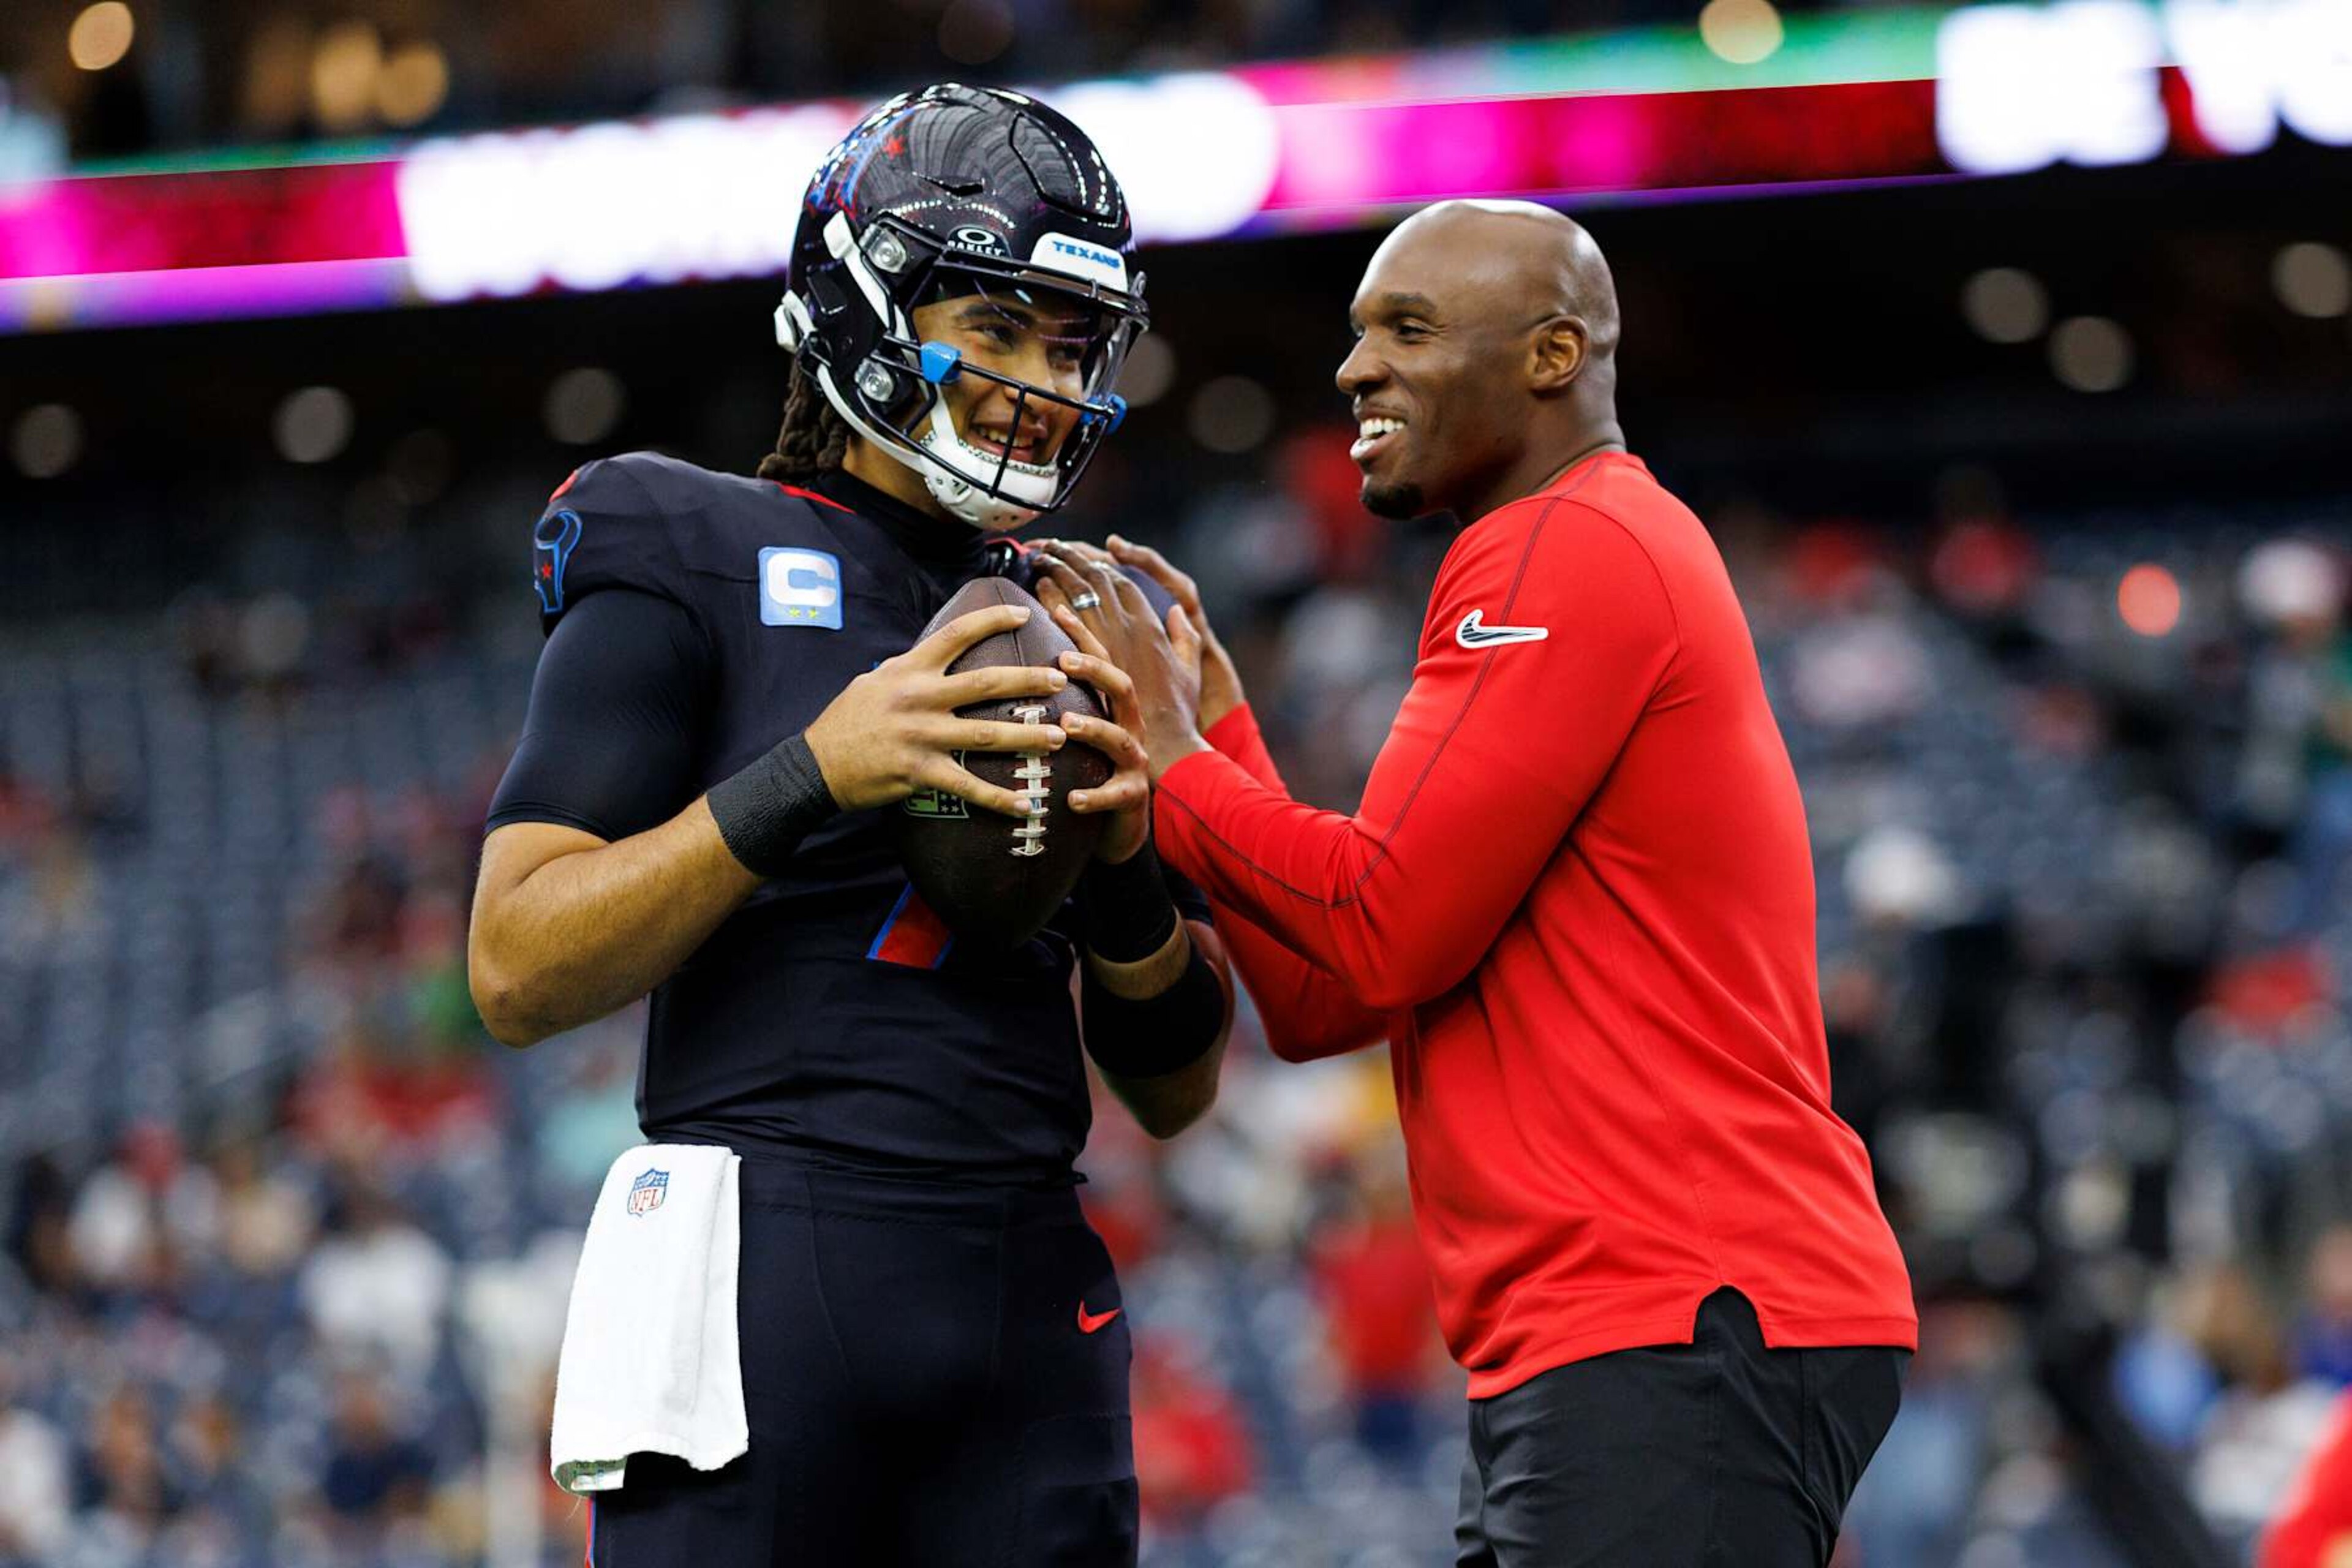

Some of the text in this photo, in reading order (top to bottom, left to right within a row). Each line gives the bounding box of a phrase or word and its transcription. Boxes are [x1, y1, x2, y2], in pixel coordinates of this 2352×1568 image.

[1052, 241, 1120, 268] TEXANS
[767, 552, 837, 607] C
[631, 1189, 660, 1212] NFL
